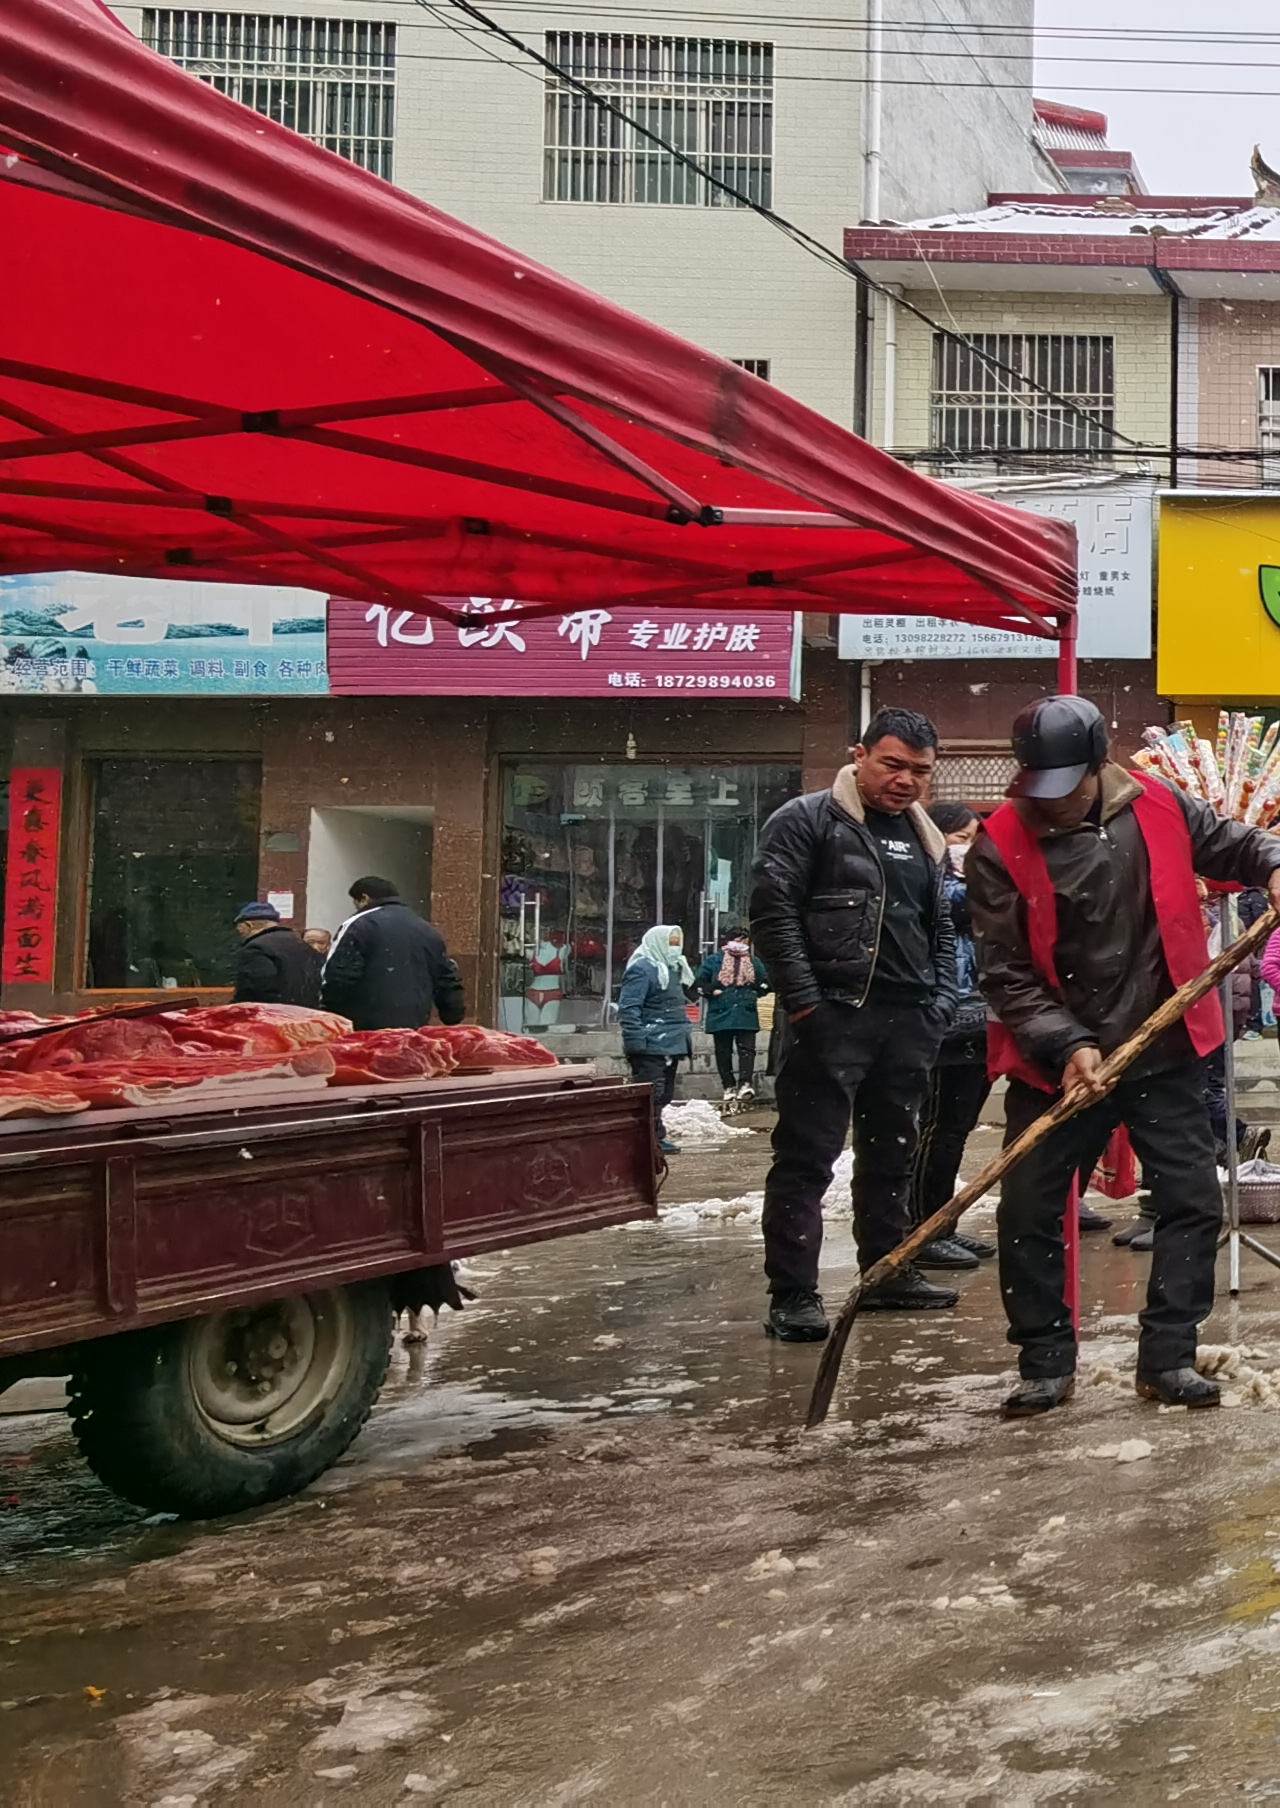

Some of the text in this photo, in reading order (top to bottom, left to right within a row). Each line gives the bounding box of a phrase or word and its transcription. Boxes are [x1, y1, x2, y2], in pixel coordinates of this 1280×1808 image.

[1098, 570, 1131, 582] 童男女
[1076, 586, 1115, 597] 蜡烧纸
[627, 620, 761, 653] 专业护肤
[862, 633, 889, 645] 电话：
[895, 633, 966, 644] 13098228272
[107, 658, 179, 678] 干鲜蔬菜
[190, 658, 224, 678] 调料
[233, 658, 268, 678] 副食
[607, 671, 777, 689] 电话： 18729894036
[572, 775, 742, 808] 顾客至上
